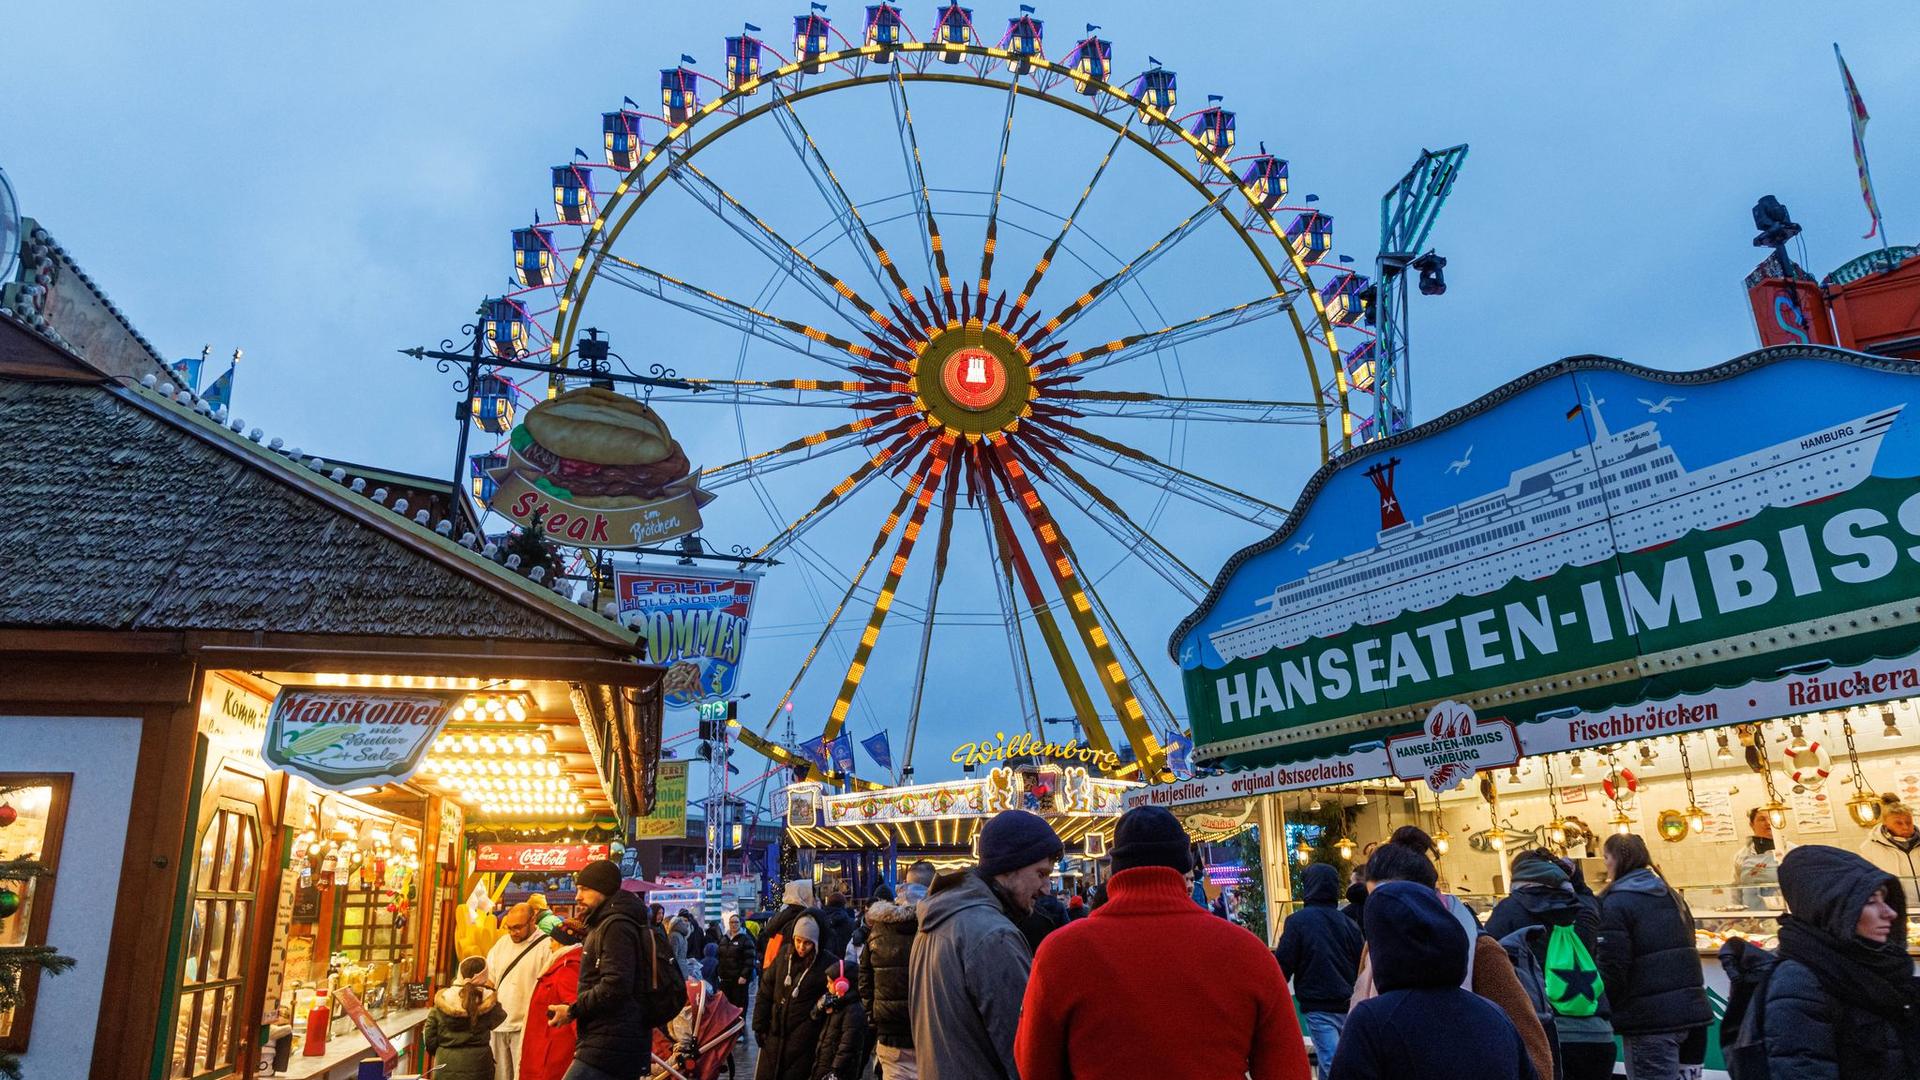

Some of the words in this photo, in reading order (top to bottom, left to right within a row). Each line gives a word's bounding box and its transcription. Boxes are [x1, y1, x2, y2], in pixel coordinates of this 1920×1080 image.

[1800, 426, 1854, 450] HAMBURG
[511, 491, 609, 542] Steak
[643, 510, 661, 520] im
[630, 516, 681, 543] Brötchen
[632, 581, 724, 597] ECHT
[623, 594, 749, 610] HOLLÄNDISCHE
[274, 699, 447, 727] Maiskolben
[1567, 701, 1718, 743] Fischbrötchen
[340, 733, 408, 747] Butter
[951, 732, 1121, 772] Willenborg
[1396, 731, 1503, 758] HANSEATEN-IMBISS
[353, 747, 399, 761] Salz
[1423, 749, 1480, 766] HAMBURG
[1231, 769, 1275, 795] original
[1278, 761, 1355, 786] Ostseelachs
[1151, 784, 1205, 805] Matjesfilet
